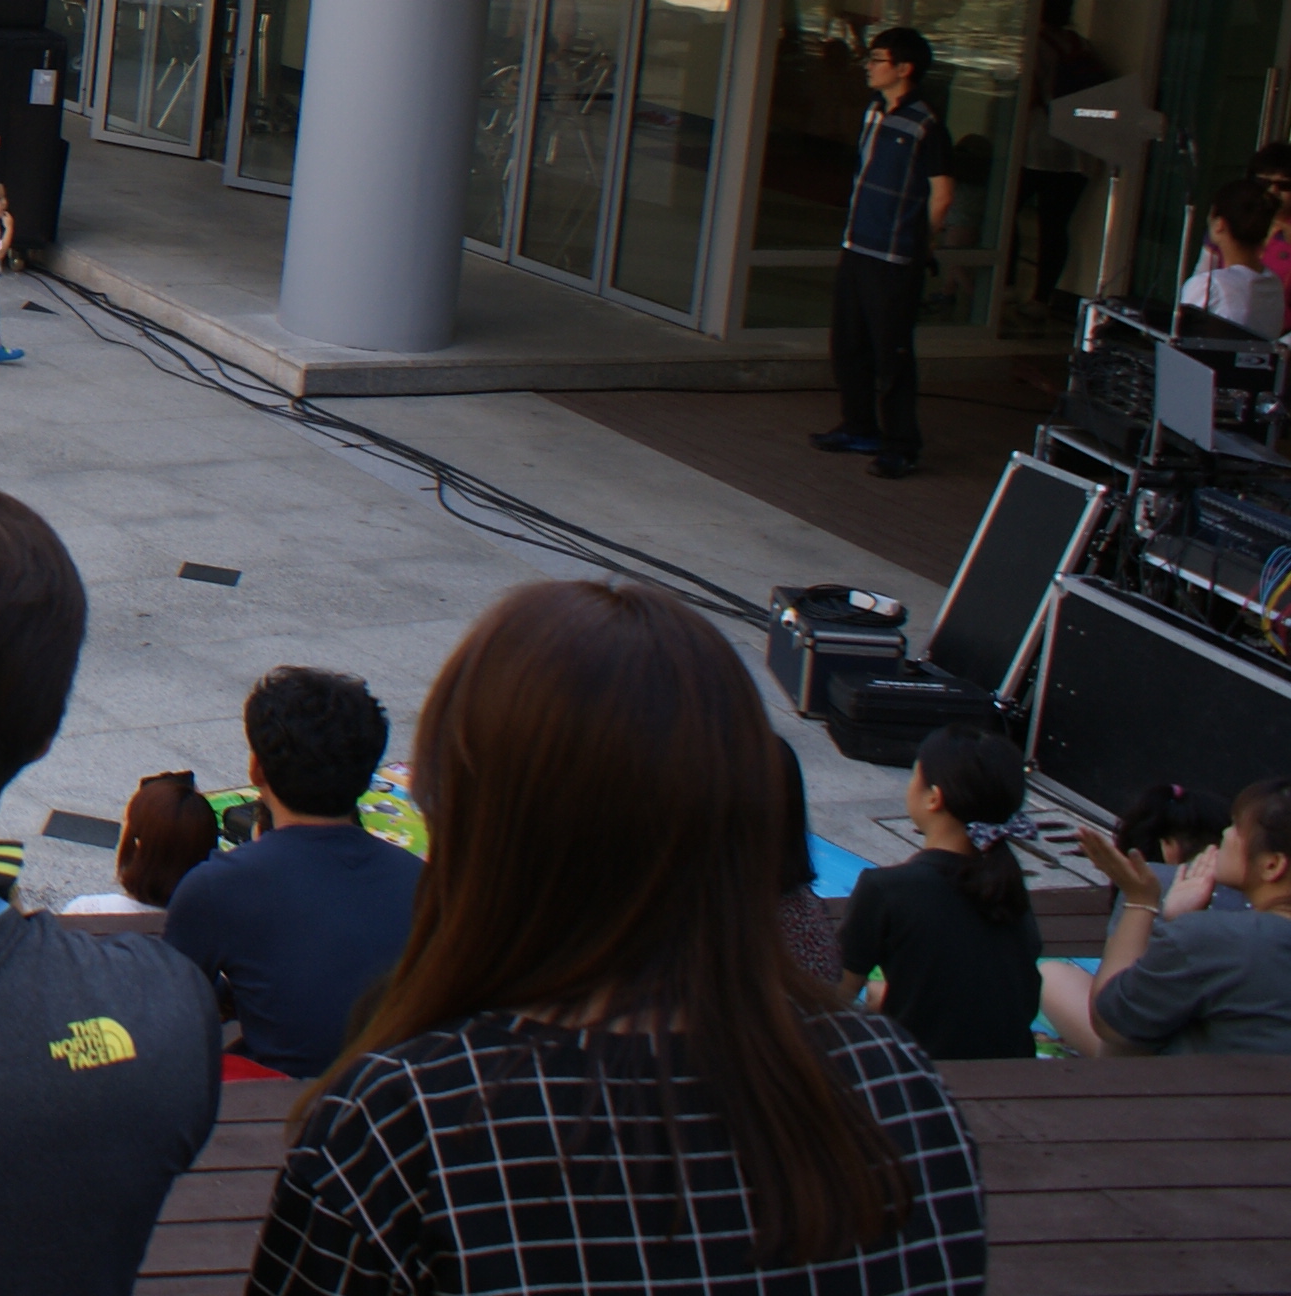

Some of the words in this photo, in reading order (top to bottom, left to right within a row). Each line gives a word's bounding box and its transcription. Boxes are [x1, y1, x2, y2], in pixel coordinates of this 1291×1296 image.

[67, 1017, 101, 1039] THE
[49, 1035, 108, 1060] NORTH
[68, 1049, 111, 1072] FACE
